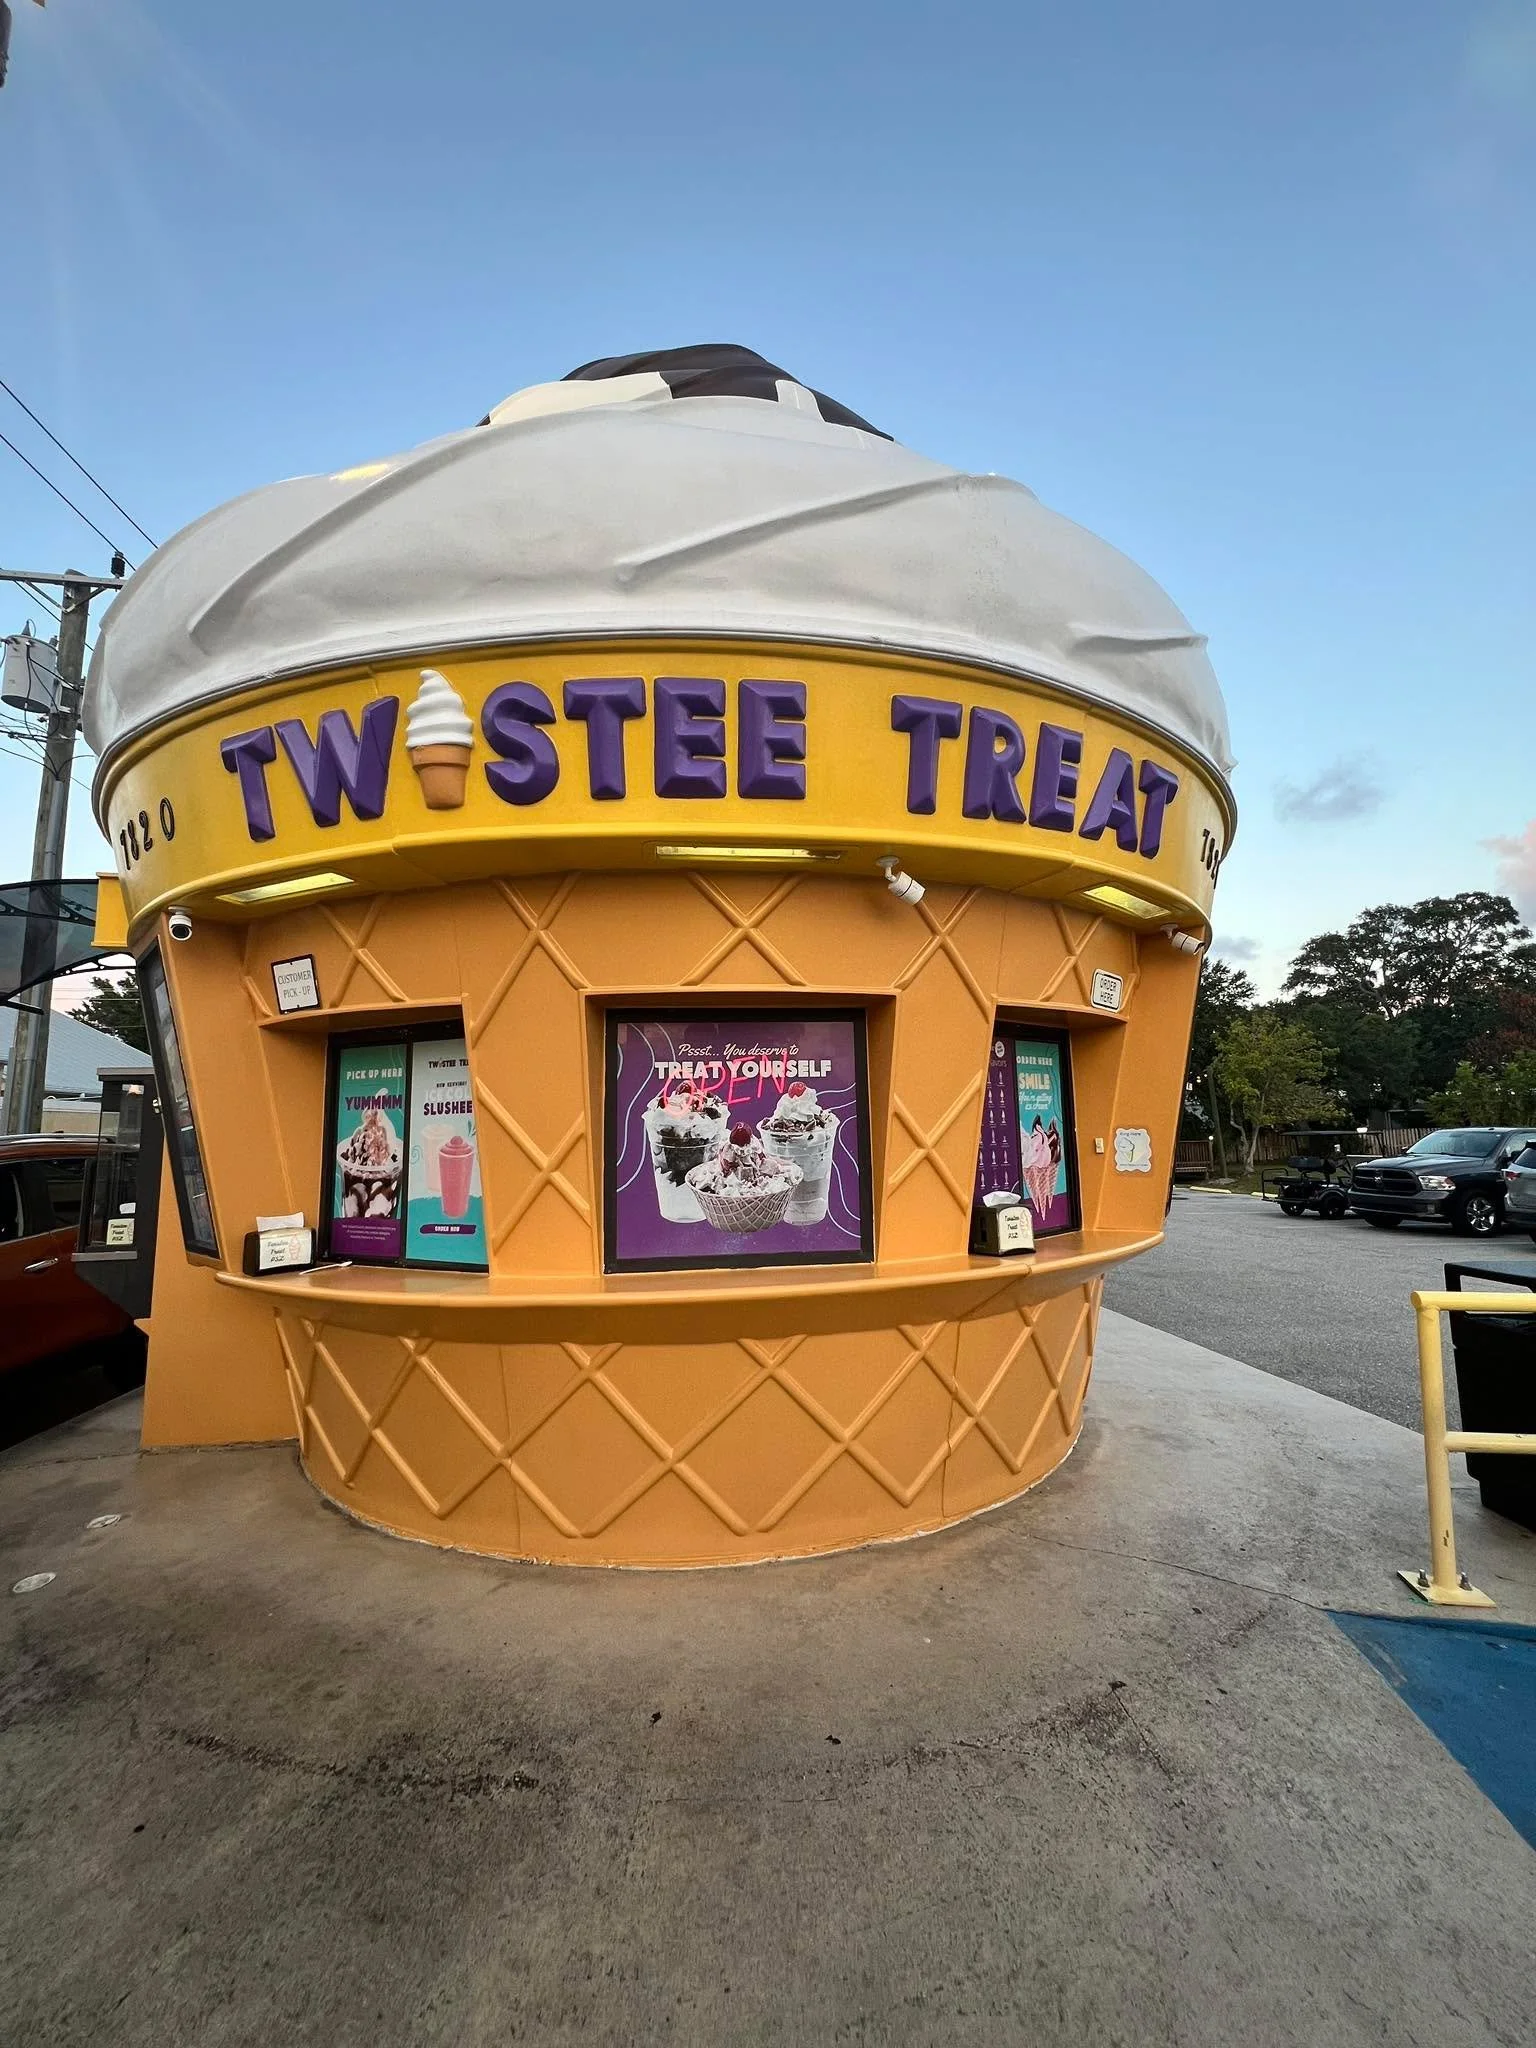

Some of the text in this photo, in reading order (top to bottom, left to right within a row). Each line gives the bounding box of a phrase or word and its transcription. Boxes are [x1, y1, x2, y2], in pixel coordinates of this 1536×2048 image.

[890, 694, 1179, 860] TREAT
[120, 796, 175, 870] 1820
[1200, 829, 1220, 890] 182
[277, 970, 312, 985] CUSTOMER
[723, 1044, 747, 1060] You
[748, 1043, 788, 1056] deserve
[789, 1045, 800, 1056] to
[1016, 1056, 1037, 1065] ORDER
[346, 1067, 402, 1080] PICK UP HERE
[654, 1059, 833, 1080] TREAT YOURSELF
[663, 1050, 789, 1117] OPEN
[1018, 1073, 1050, 1090] SMILE
[445, 1087, 472, 1100] COL
[344, 1094, 403, 1111] YUMMMM
[424, 1100, 472, 1116] SLUSHEE
